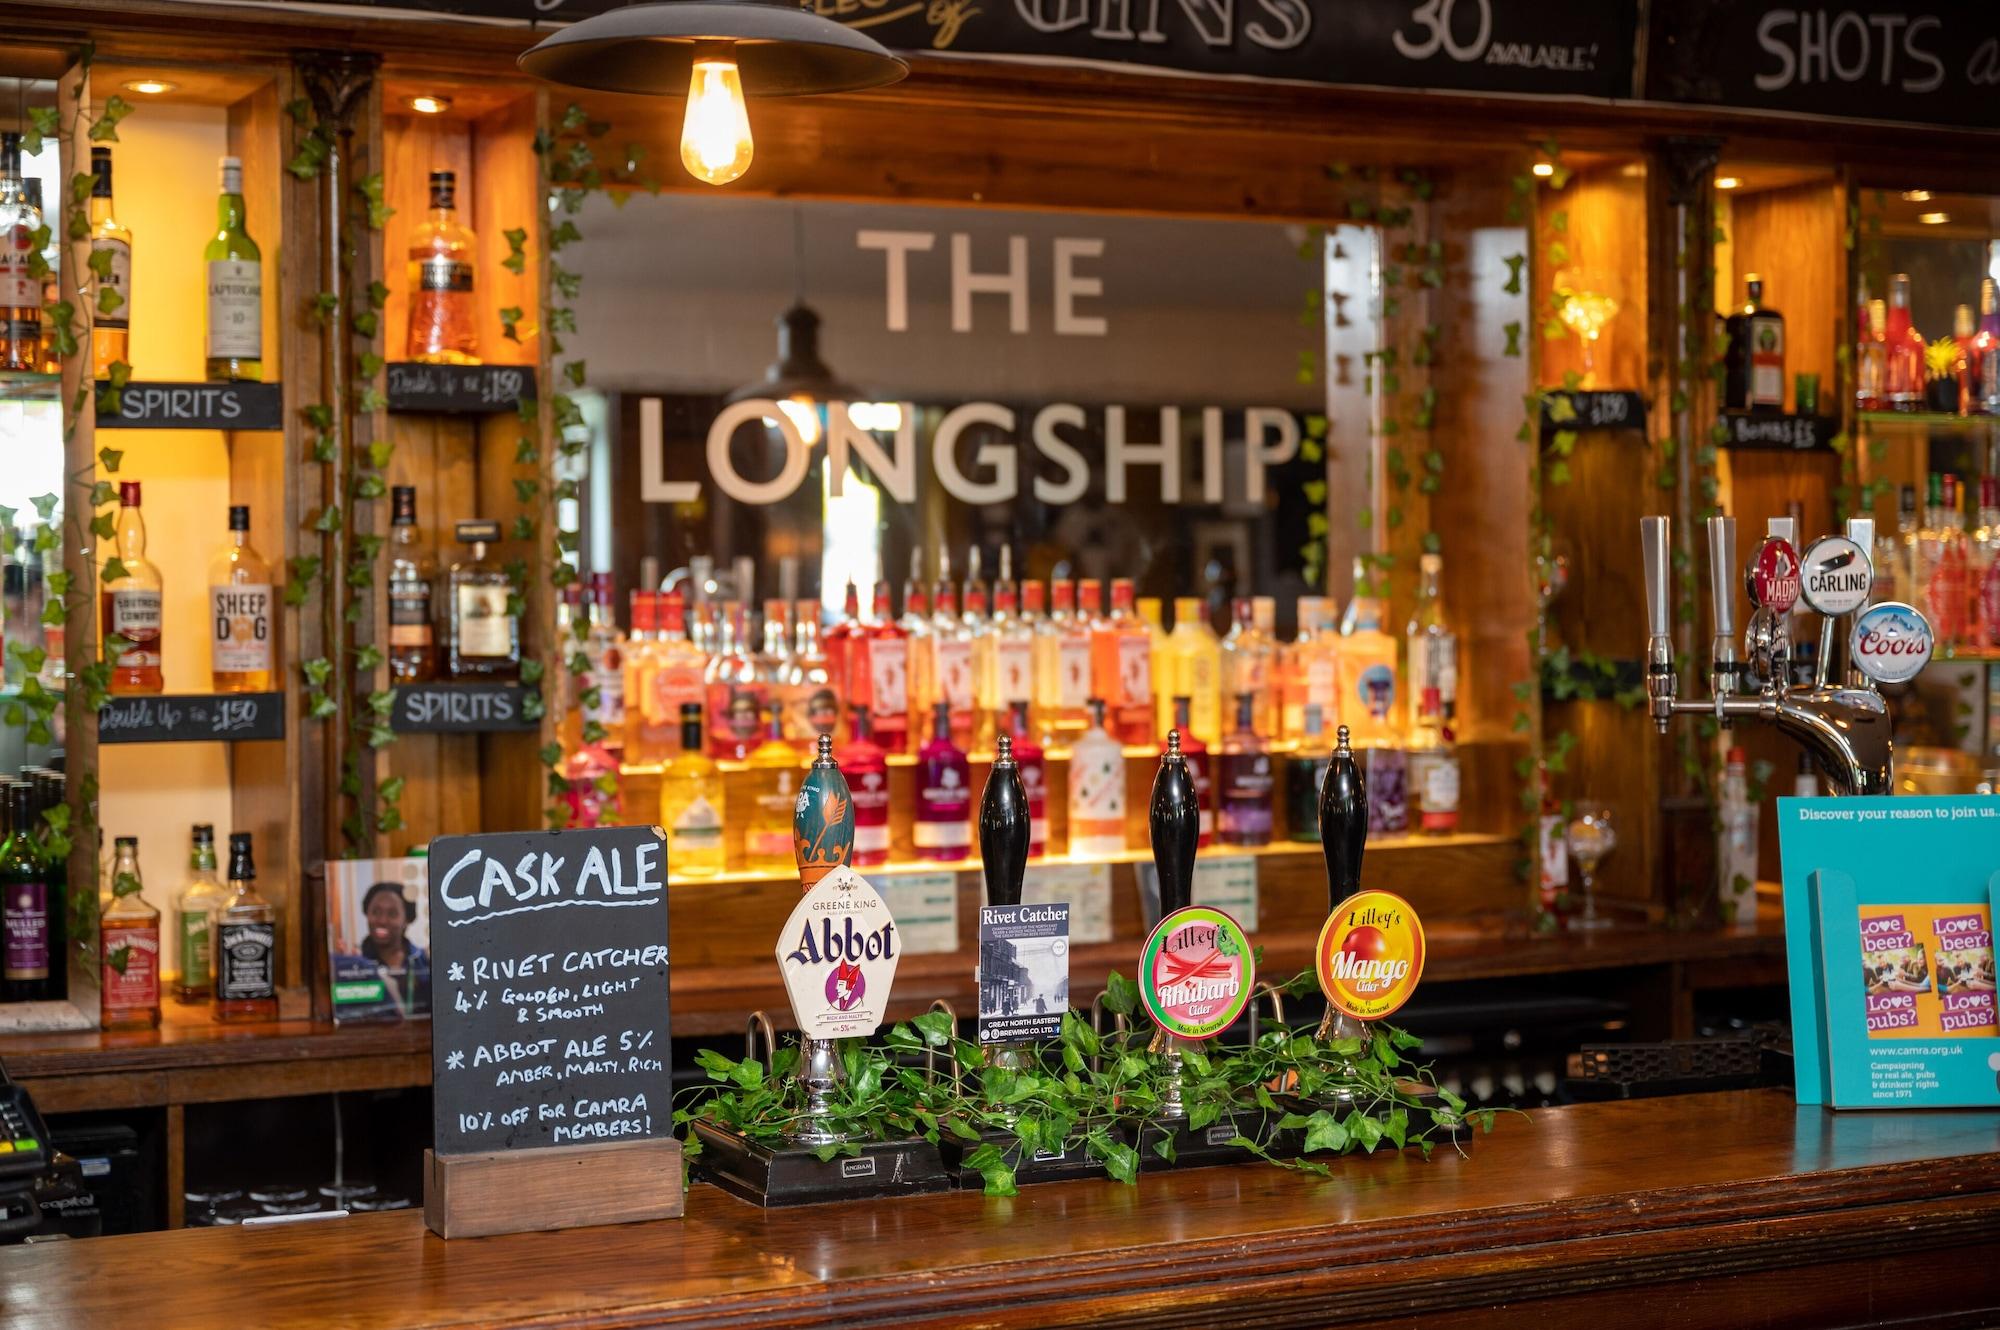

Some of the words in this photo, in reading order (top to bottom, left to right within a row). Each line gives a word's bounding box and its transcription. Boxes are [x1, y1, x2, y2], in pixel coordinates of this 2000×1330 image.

[1391, 0, 1492, 62] 30
[1754, 9, 1945, 93] SHOTS
[857, 229, 1108, 335] THE
[121, 389, 242, 419] SPIRITS
[639, 396, 1300, 506] LONGSHIP
[1810, 573, 1866, 592] CARLING
[216, 593, 267, 614] SHEEP
[1859, 631, 1926, 656] Coors
[405, 691, 514, 723] SPIRITS
[1799, 808, 1855, 821] Discover
[1857, 810, 1887, 822] your
[1889, 808, 1934, 819] reason
[1936, 807, 1949, 818] to
[1951, 805, 1978, 821] join
[440, 848, 565, 912] CASK
[575, 842, 663, 896] ALE
[812, 901, 851, 911] GREENE
[853, 899, 877, 909] KING
[982, 909, 1017, 925] Rivet
[1019, 905, 1068, 923] Catcher
[5, 918, 46, 929] MULLED
[1348, 907, 1401, 930] Lilley's
[11, 928, 40, 938] WINE
[785, 916, 895, 966] Abbot
[1160, 923, 1228, 954] Lilley's
[1863, 931, 1913, 952] beer?
[1941, 931, 1991, 952] beer?
[472, 953, 555, 985] RIVET
[562, 945, 670, 973] CATCHER
[1331, 950, 1409, 988] Mango
[454, 989, 488, 1014] 4%
[582, 977, 641, 998] LIGHT
[1157, 977, 1240, 1008] Rhubarb
[1355, 980, 1380, 992] Cider
[516, 1007, 529, 1023] &
[536, 1003, 604, 1023] SMOOTH
[1188, 1003, 1213, 1017] Cider
[1345, 1001, 1359, 1013] Made
[1366, 1003, 1390, 1014] Somerset
[987, 1020, 1009, 1029] GREAT
[1009, 1018, 1032, 1027] NORTH
[1032, 1016, 1061, 1025] EASTERN
[999, 1028, 1029, 1037] BREWING
[1029, 1027, 1041, 1035] CO.
[1041, 1025, 1055, 1034] LTD.
[1177, 1023, 1192, 1034] Made
[1200, 1018, 1225, 1033] Somerset
[1941, 1008, 1996, 1033] pubs?
[472, 1038, 558, 1068] ABBOT
[564, 1034, 608, 1059] ALE
[619, 1030, 654, 1051] 5%
[1869, 1045, 1964, 1057] www.camra.org.uk
[628, 1056, 662, 1073] RICH
[1870, 1062, 1925, 1071] Campaigning
[1871, 1071, 1883, 1080] for
[1884, 1071, 1900, 1080] real
[1916, 1070, 1936, 1081] pubs
[1915, 1080, 1940, 1090] rights
[1872, 1091, 1895, 1099] since
[1895, 1089, 1913, 1098] 1971
[459, 1111, 495, 1134] 10%
[500, 1106, 530, 1126] OFF
[538, 1103, 567, 1121] FOR
[573, 1093, 648, 1119] CAMRA
[553, 1115, 651, 1143] MEMBERS!
[844, 1163, 873, 1172] ANGRAM
